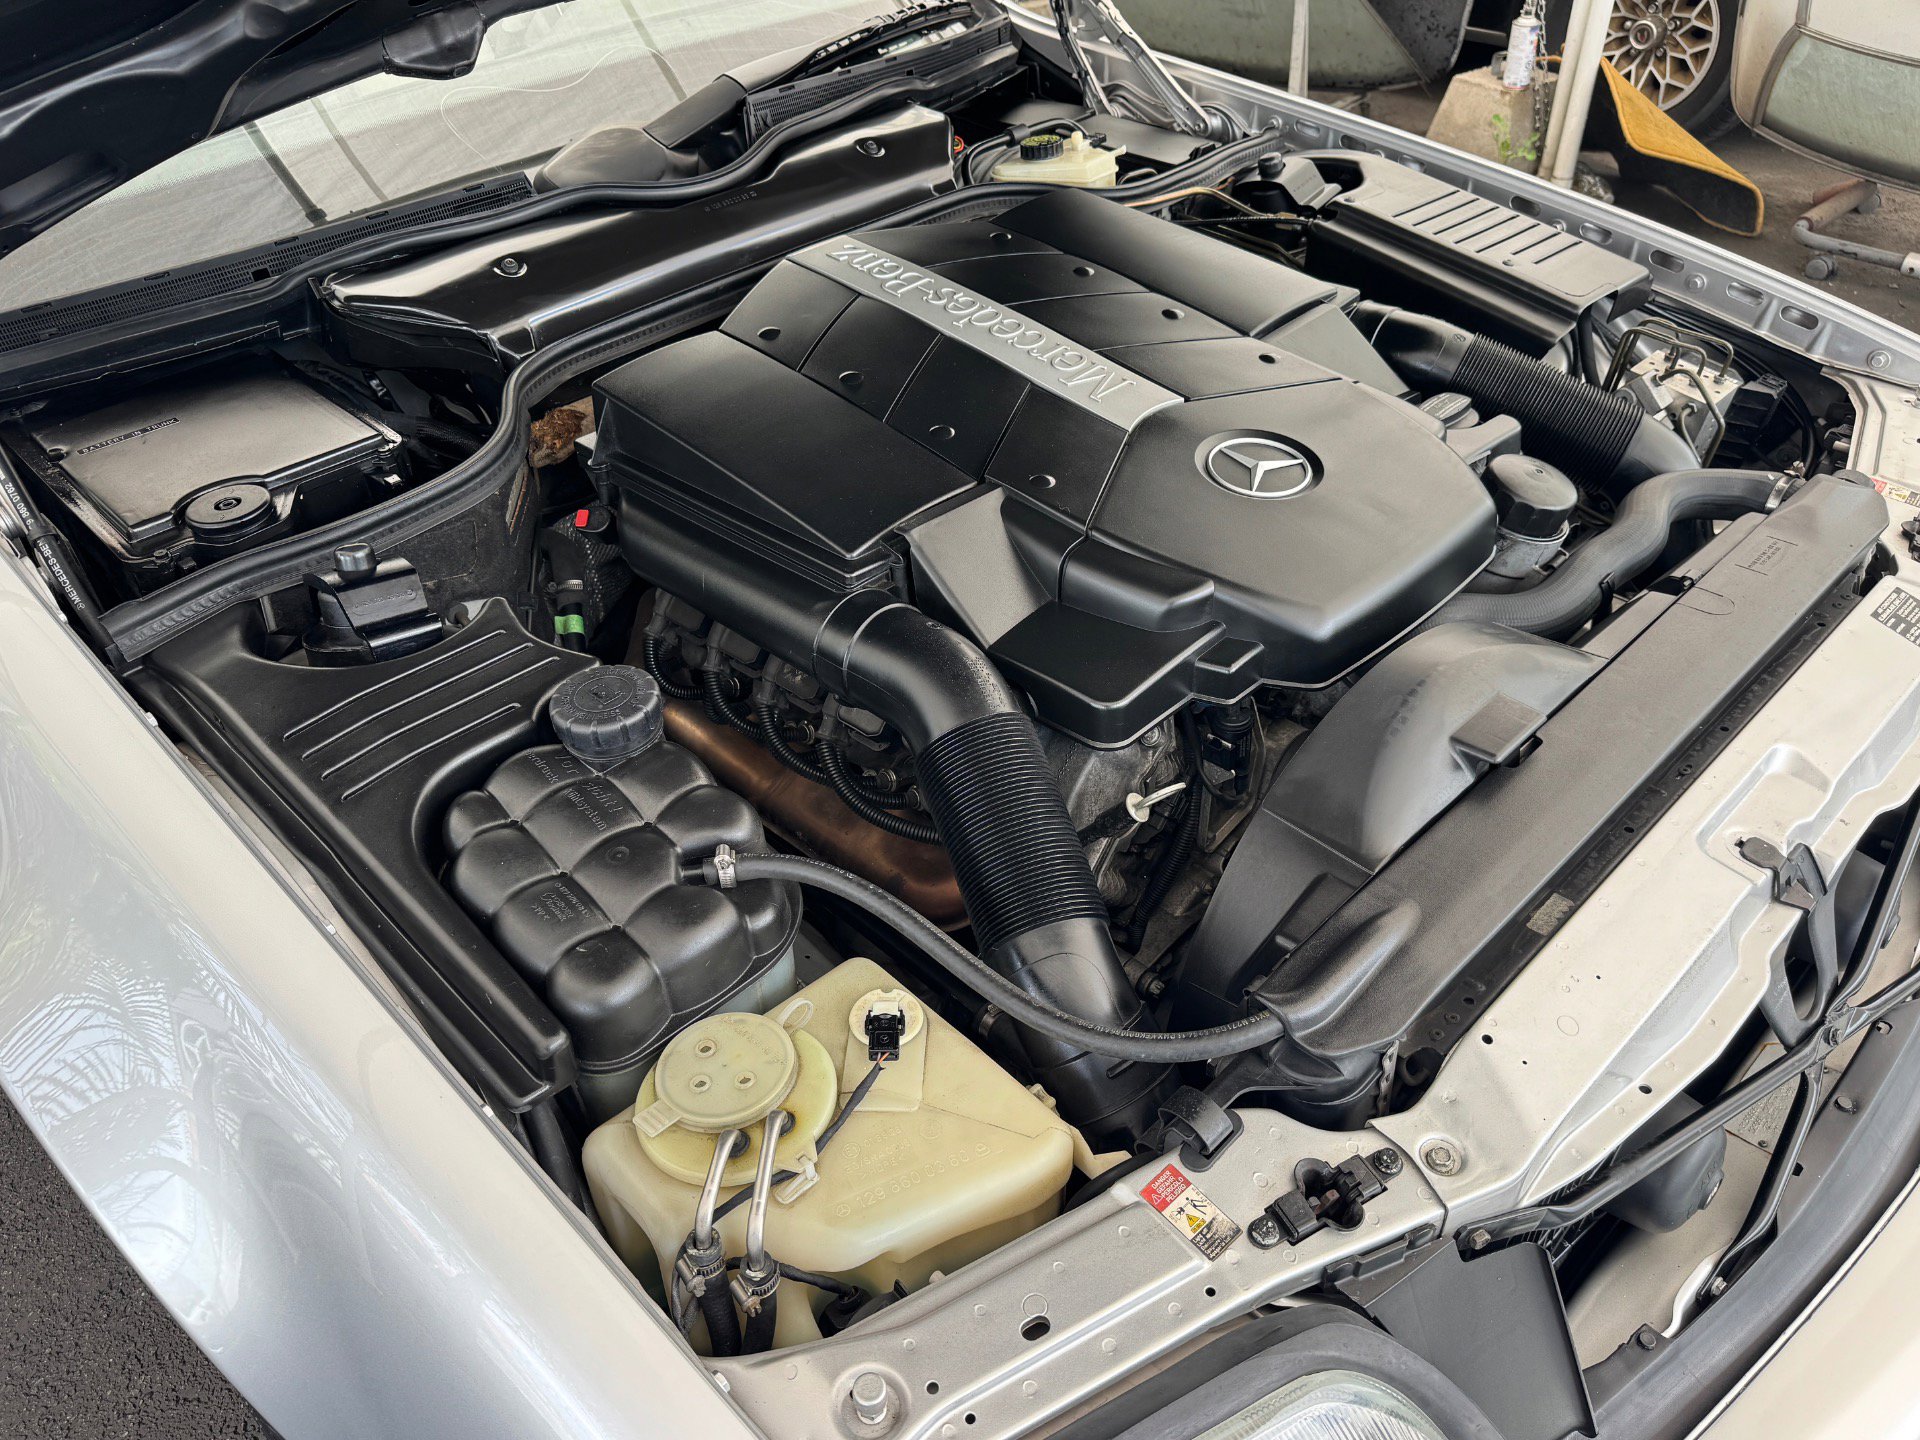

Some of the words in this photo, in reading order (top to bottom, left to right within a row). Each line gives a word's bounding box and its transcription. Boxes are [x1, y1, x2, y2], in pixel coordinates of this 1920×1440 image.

[825, 243, 1138, 405] Mercedes-Benz
[82, 435, 125, 453] BATTERY
[132, 429, 142, 438] IN
[147, 418, 176, 432] TRUNK
[37, 539, 81, 604] MERCEDES-BEN
[1151, 1170, 1172, 1189] DANGER
[1156, 1176, 1176, 1194] GEFAHR
[1161, 1176, 1184, 1198] PERICOLO
[856, 1187, 886, 1208] 129
[1165, 1183, 1187, 1203] PELIGRO
